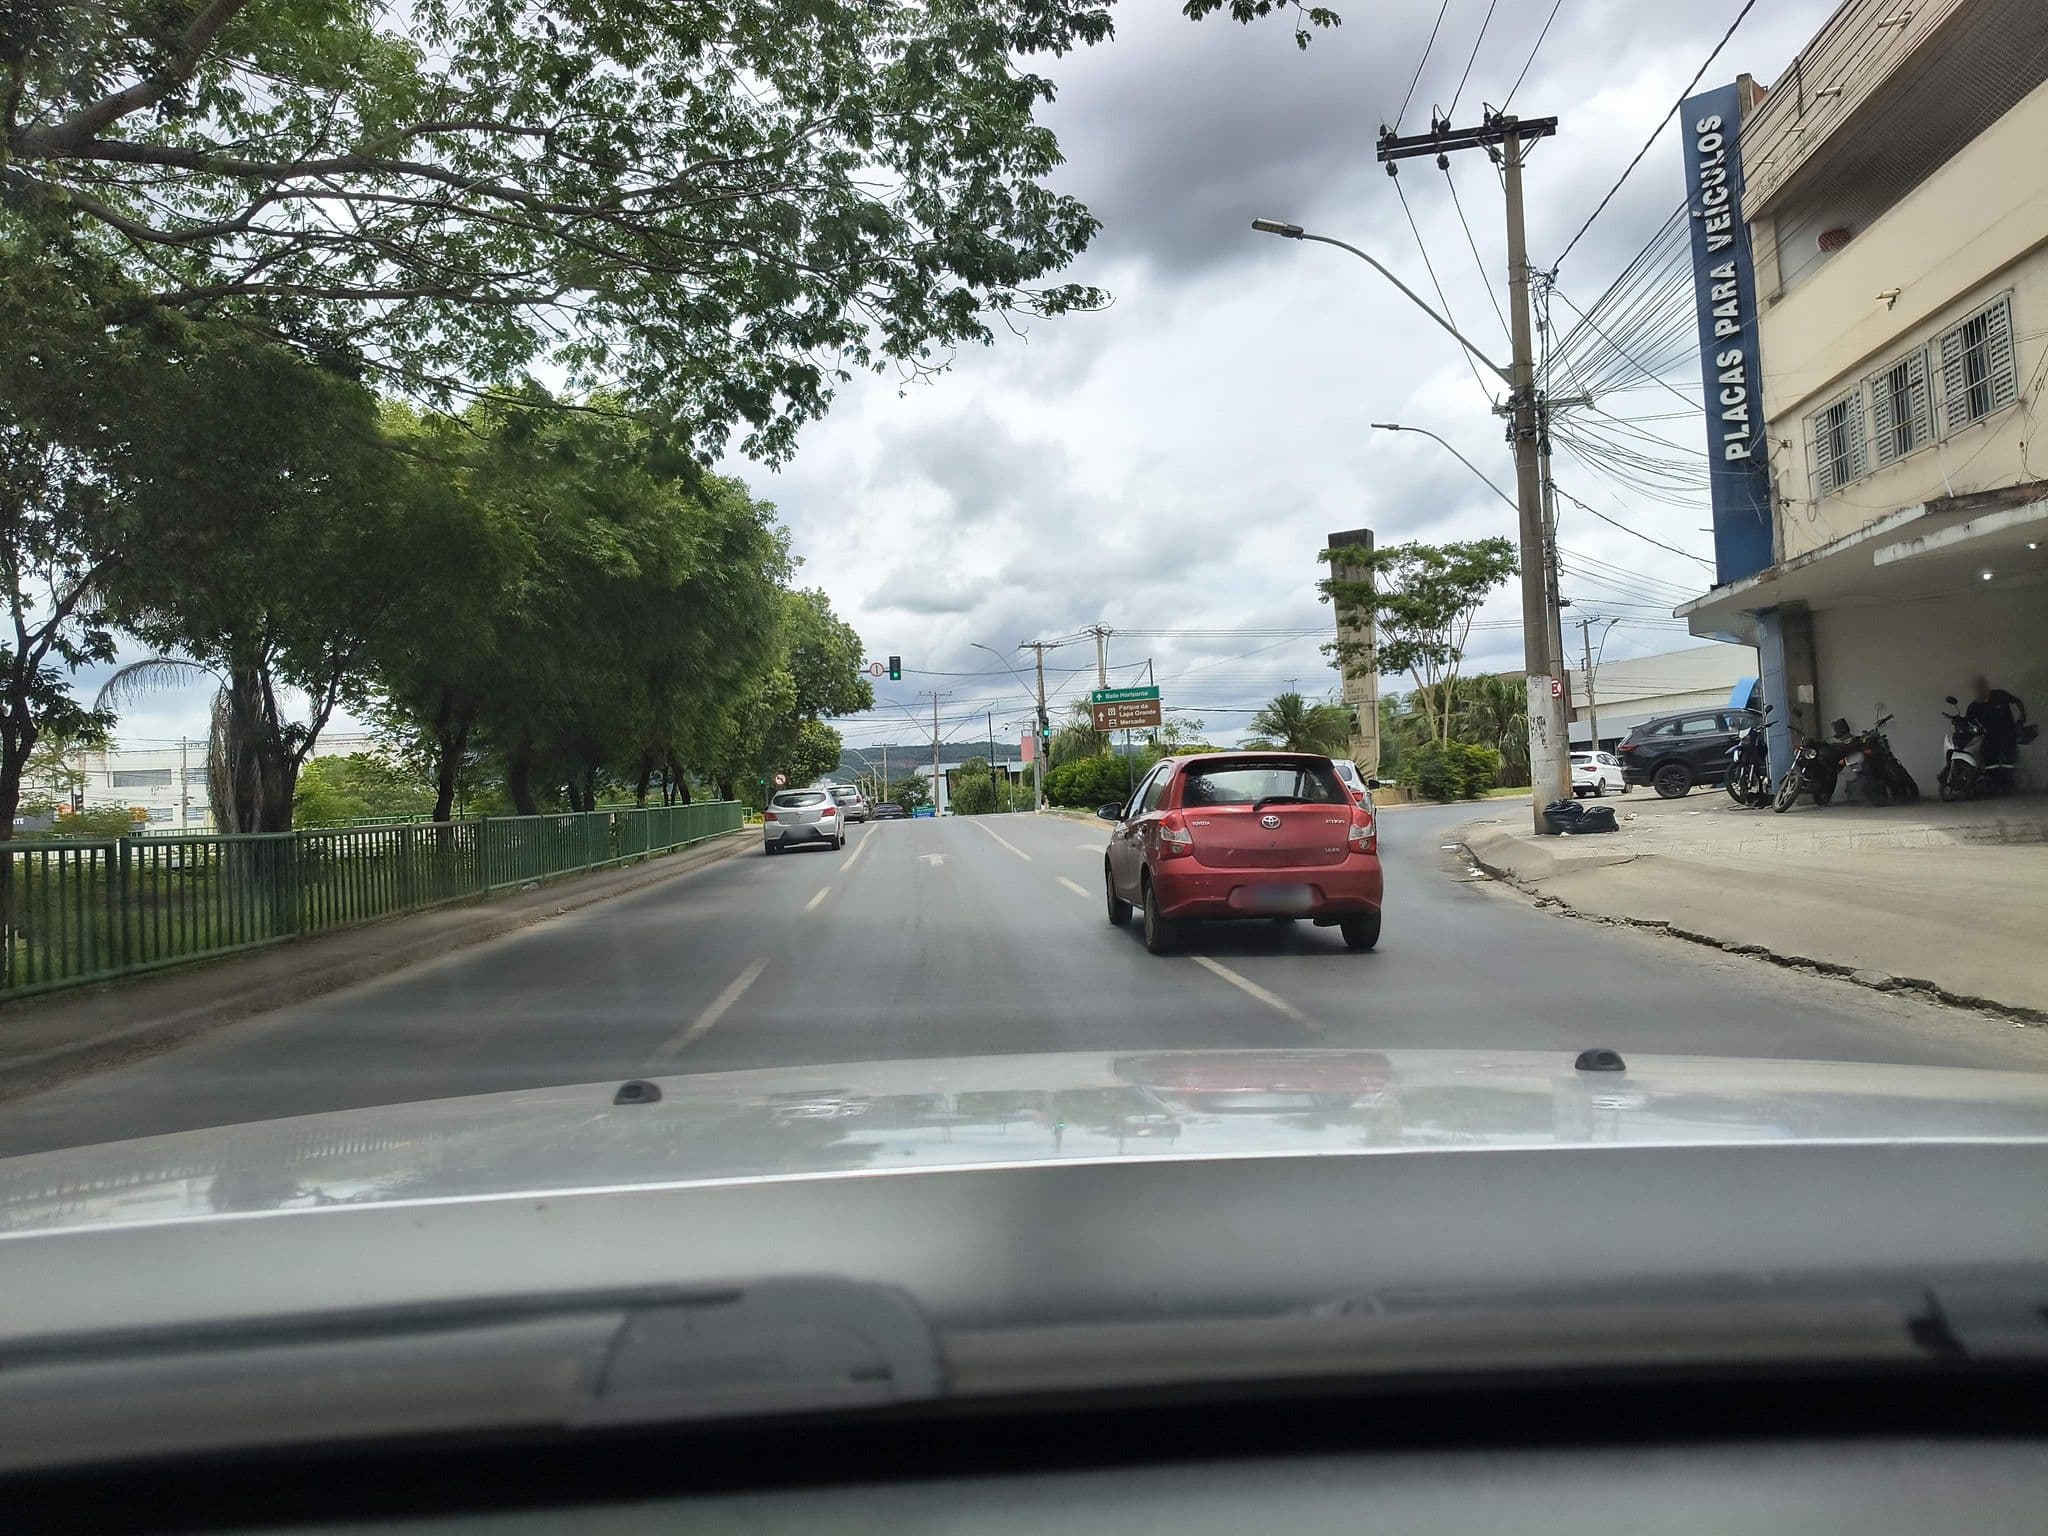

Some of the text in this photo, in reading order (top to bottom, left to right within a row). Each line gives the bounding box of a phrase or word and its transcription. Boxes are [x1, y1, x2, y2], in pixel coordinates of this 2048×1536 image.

[1692, 115, 1751, 461] PLACAS PARA VEÍCULOS
